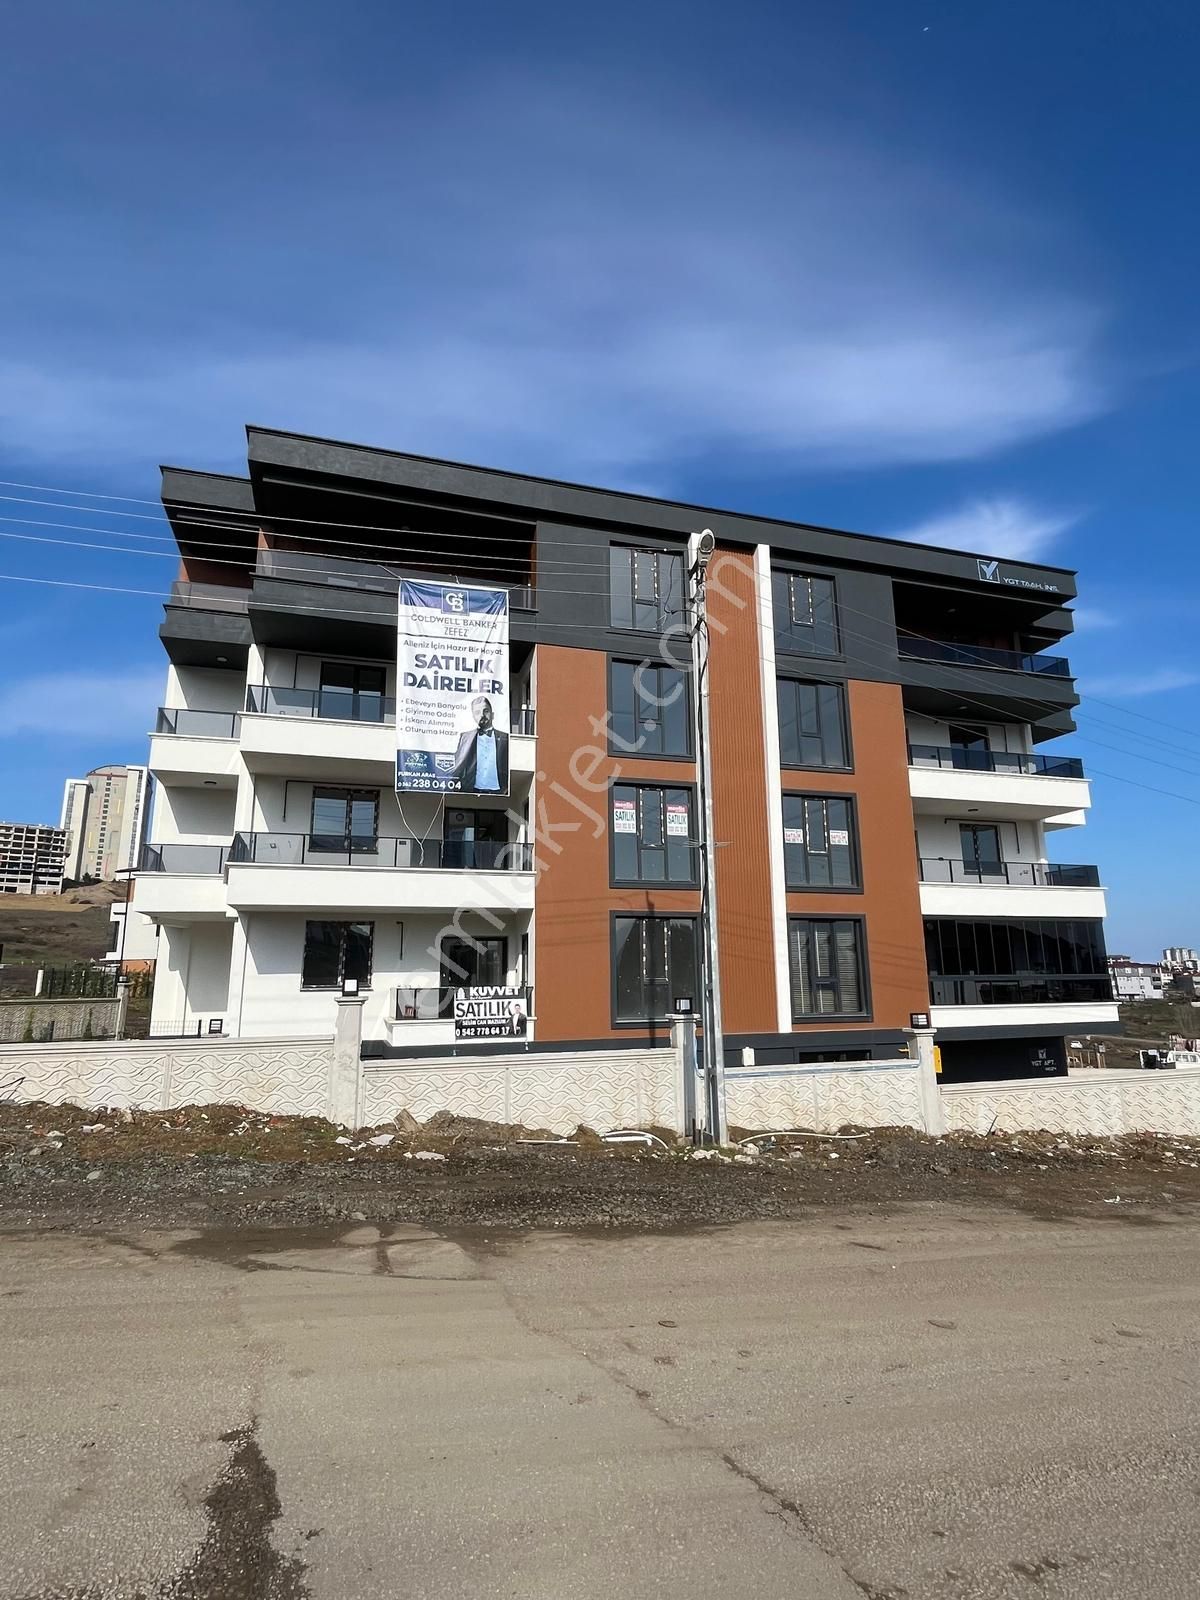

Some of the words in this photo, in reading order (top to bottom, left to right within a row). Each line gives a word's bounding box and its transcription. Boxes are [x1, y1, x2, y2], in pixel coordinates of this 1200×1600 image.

[1003, 577, 1019, 585] YGT
[411, 614, 460, 626] COLDWELL
[463, 619, 497, 629] BANKER
[444, 627, 469, 637] ZEFEZ
[404, 640, 429, 648] Aileniz
[431, 641, 445, 650] İçin
[447, 644, 466, 652] Hazır
[481, 648, 503, 656] Hayat
[414, 654, 494, 673] SATILIK
[403, 671, 504, 695] DAİRELER
[405, 698, 436, 709] Ebeveyn
[437, 701, 467, 710] Banyolu
[405, 708, 435, 716] Giyinme
[405, 715, 426, 724] İskanı
[428, 719, 455, 728] Alınmış
[405, 726, 438, 735] Oturuma
[412, 779, 431, 788] 238
[432, 780, 446, 789] 04
[447, 781, 462, 790] 04
[615, 811, 635, 821] SATILIK
[668, 814, 687, 824] SATILIK
[470, 986, 520, 997] KUVVET
[456, 1001, 512, 1018] SATILIK
[455, 1028, 460, 1037] 0
[461, 1028, 476, 1036] 542
[477, 1027, 490, 1036] 778
[491, 1027, 500, 1035] 64
[501, 1026, 510, 1035] 17
